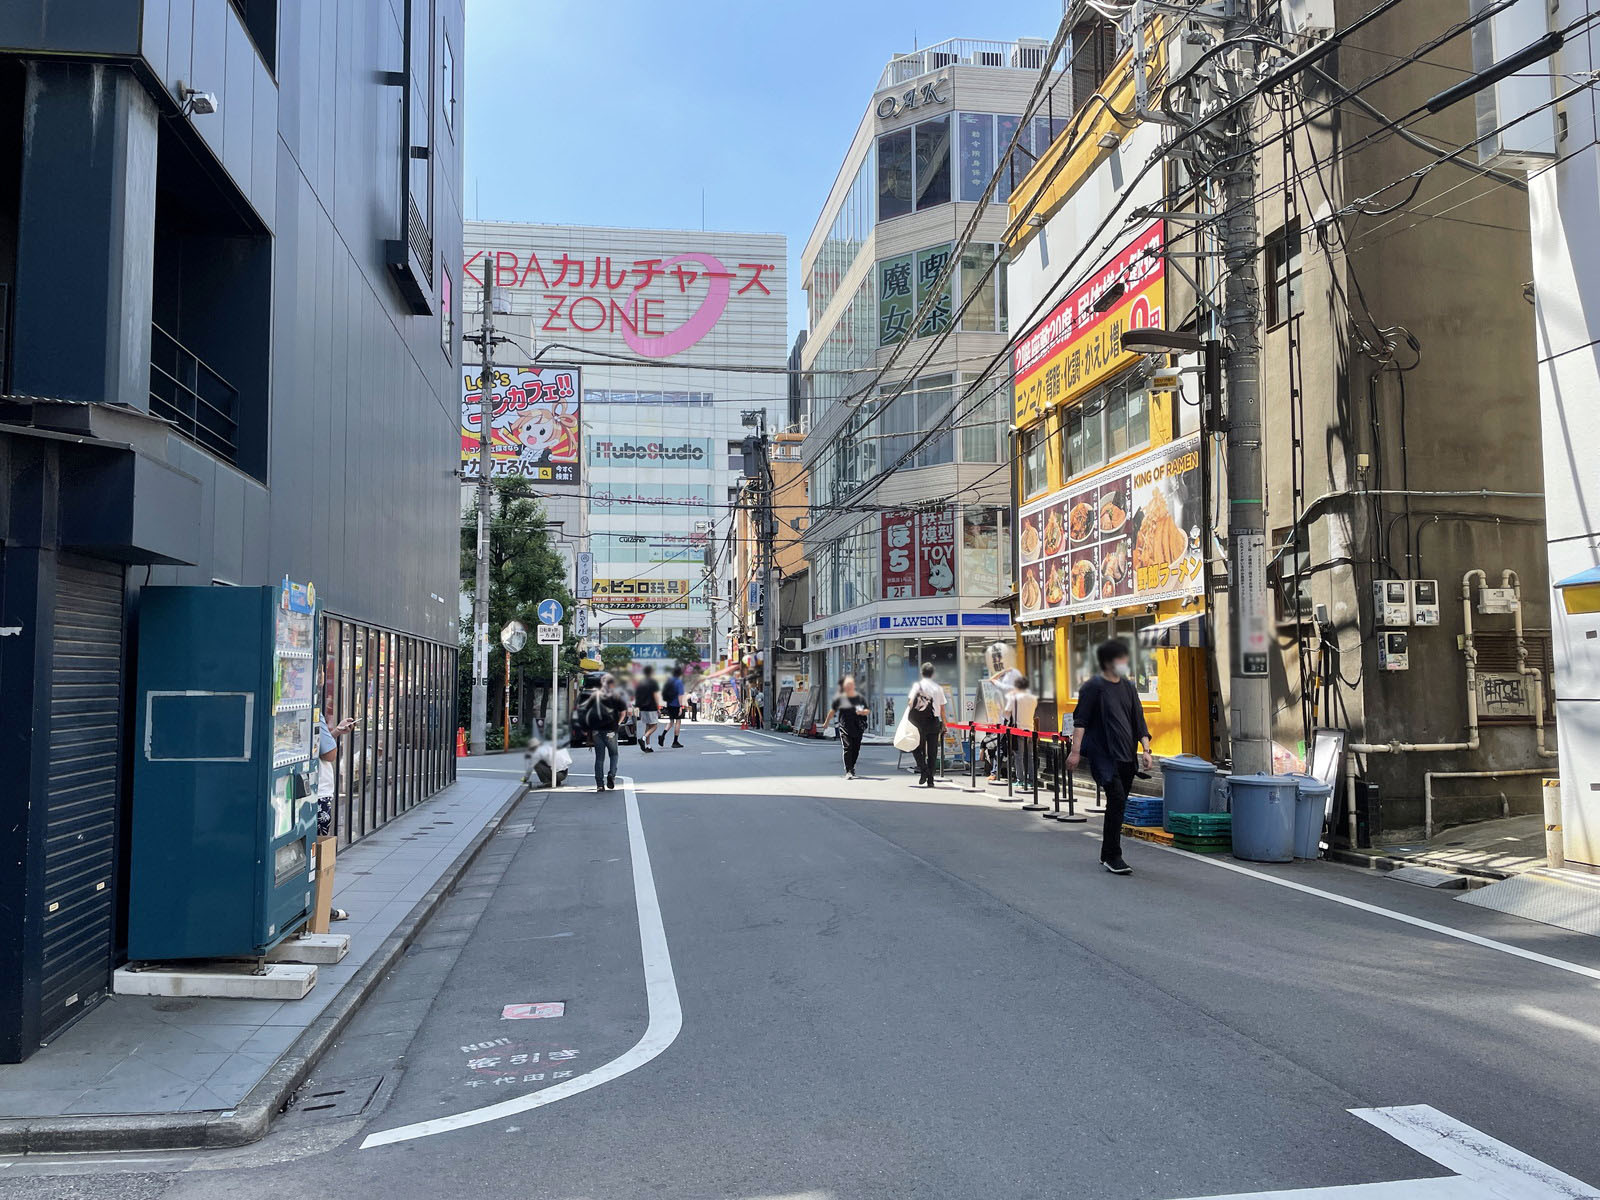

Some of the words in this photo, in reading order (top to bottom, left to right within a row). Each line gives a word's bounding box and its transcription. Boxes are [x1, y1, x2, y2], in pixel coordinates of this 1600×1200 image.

[876, 78, 948, 119] OAK
[463, 250, 776, 296] KBAカルチャーズ
[542, 295, 665, 335] ZONE
[882, 263, 911, 342] 魔女
[465, 370, 511, 391] Le's
[1133, 470, 1152, 490] KING
[1153, 465, 1165, 480] OF
[1166, 451, 1199, 476] RAMEN
[887, 520, 912, 573] ぽち
[921, 525, 954, 545] 模型
[921, 545, 954, 561] TOY
[1137, 556, 1203, 592] 野郎ラーメン
[893, 587, 906, 598] 2F
[893, 616, 944, 627] LAWSON
[1041, 628, 1055, 642] OUT
